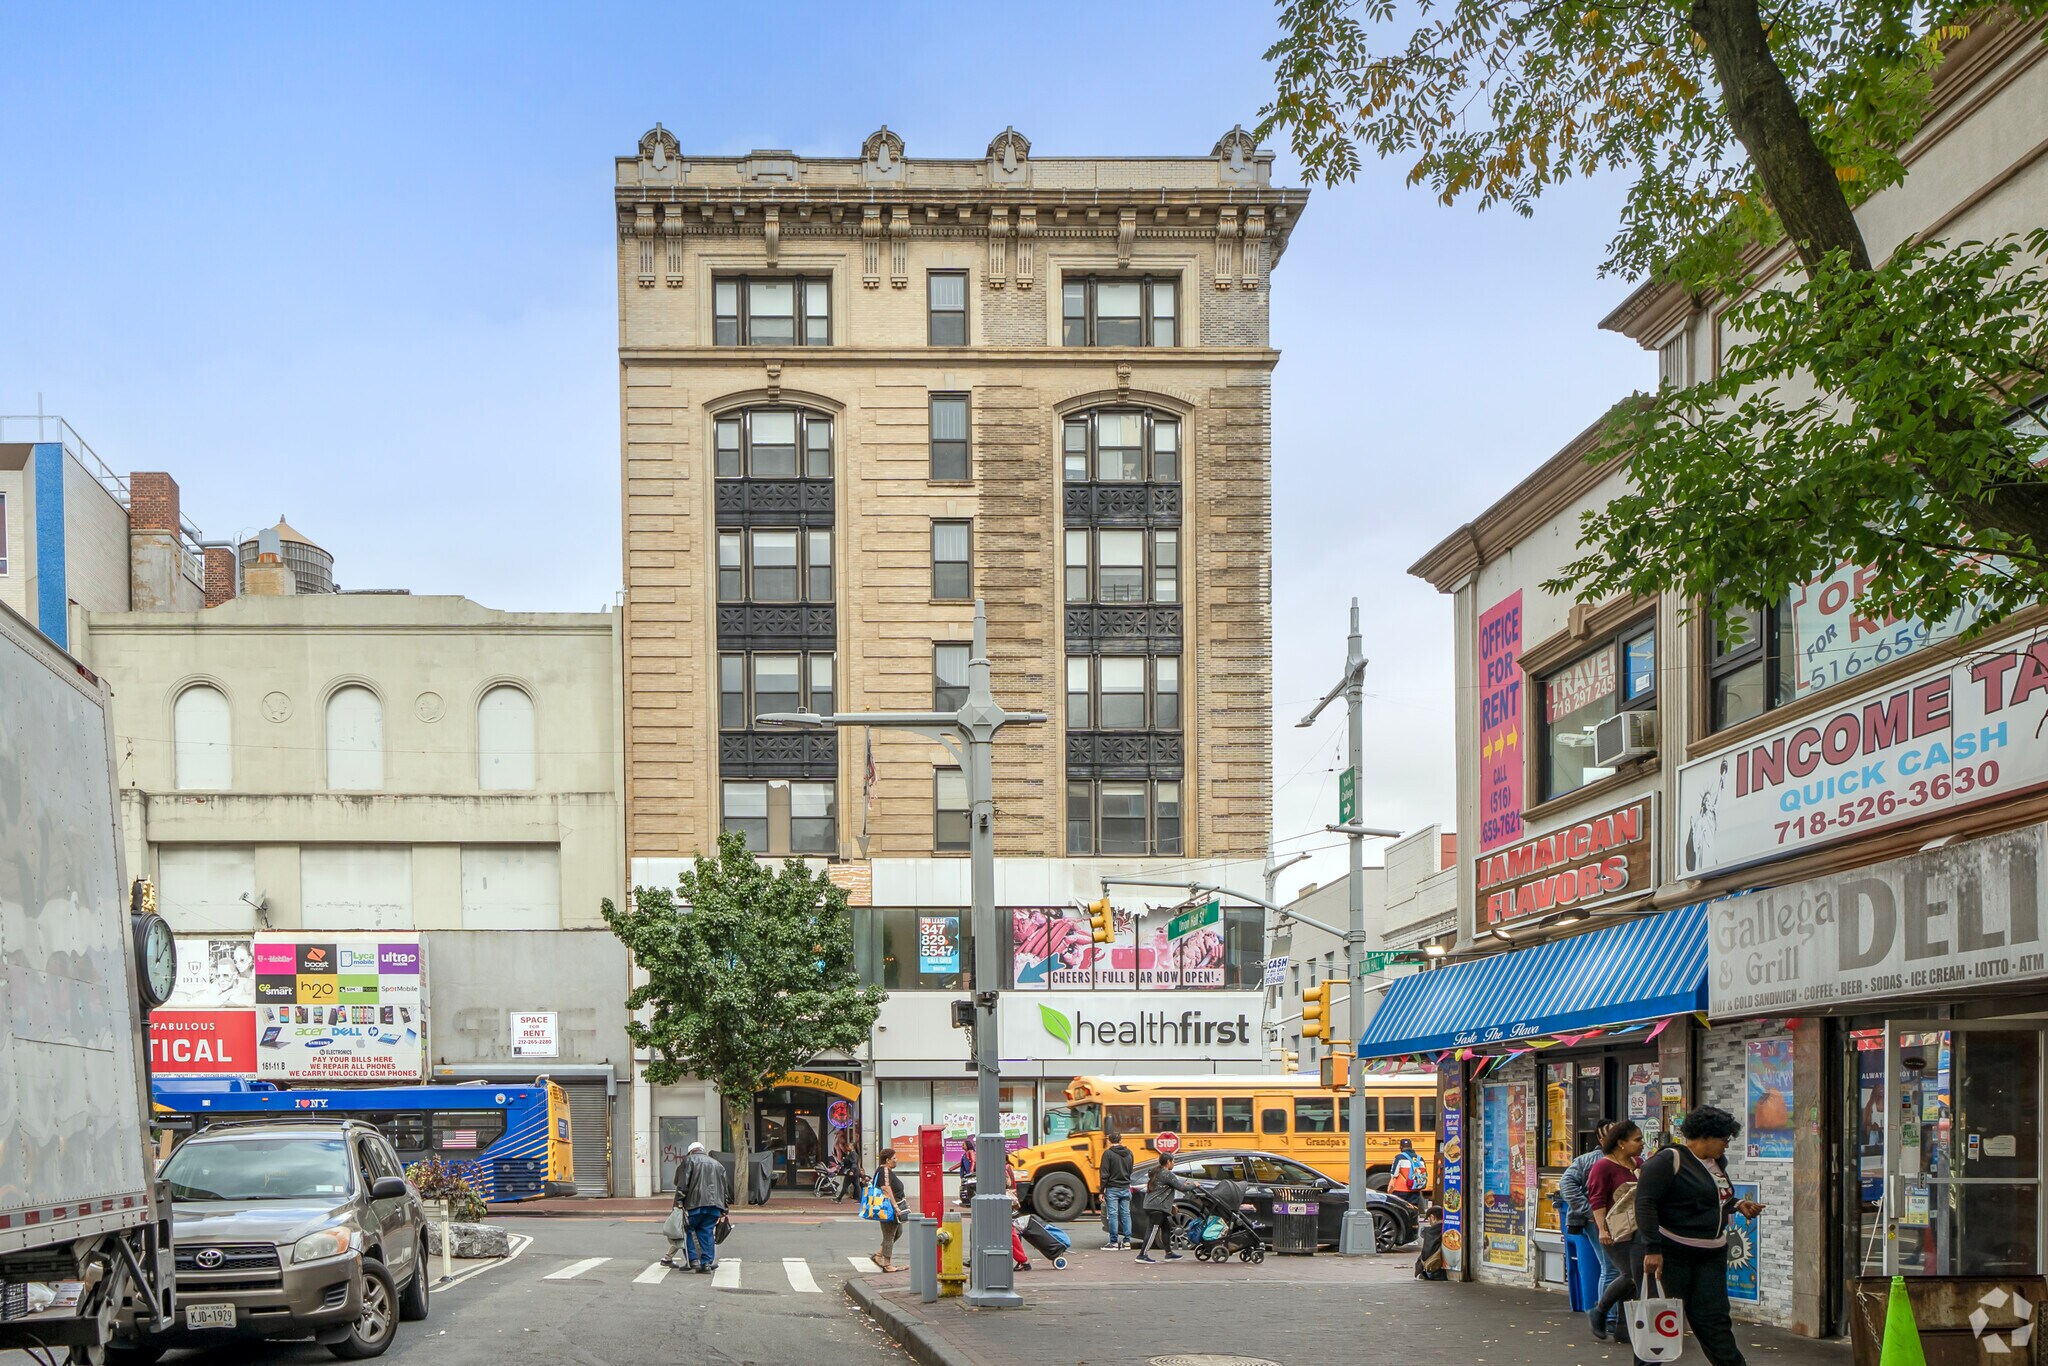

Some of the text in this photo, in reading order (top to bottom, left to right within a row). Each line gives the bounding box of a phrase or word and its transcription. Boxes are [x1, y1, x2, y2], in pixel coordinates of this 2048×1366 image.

[1482, 607, 1518, 660] OFFICE
[1806, 624, 1838, 663] FOR
[1488, 651, 1513, 689] FOR
[1482, 680, 1519, 733] RENT
[1552, 698, 1571, 719] 718
[1574, 686, 1592, 710] 297
[1735, 674, 1951, 798] INCOME
[1493, 764, 1507, 786] CALL
[1779, 721, 2008, 813] QUICK CASH
[1490, 785, 1511, 814] (516)
[1774, 760, 2000, 845] 718-526-3630
[1483, 809, 1520, 843] 659-7621
[1477, 804, 1644, 891] JAMAICAN
[1487, 855, 1630, 926] FLAVORS
[1838, 840, 2040, 971] DELI
[921, 924, 945, 935] 347
[1714, 890, 1836, 955] Gallega
[921, 935, 946, 946] 829
[921, 946, 954, 957] 5547
[353, 952, 375, 960] Lyca
[1268, 957, 1288, 969] CASH
[1719, 945, 1800, 990] & Grill
[1102, 971, 1126, 983] FULL
[1156, 971, 1179, 983] NOW
[1185, 971, 1214, 983] OPEN!
[1728, 1002, 1733, 1011] &
[1734, 995, 1753, 1010] COLD
[1755, 988, 1797, 1007] SANDWICH
[1804, 983, 1833, 1000] COFFEE
[1841, 980, 1862, 995] BEER
[1871, 974, 1902, 992] SODAS
[1911, 970, 1926, 987] ICE
[1929, 965, 1965, 984] CREAM
[1975, 958, 2008, 978] LOTTO
[2019, 953, 2044, 972] ATM
[153, 1022, 215, 1031] FABULOUS
[295, 1027, 327, 1036] acer
[332, 1027, 362, 1036] DELL
[1076, 1010, 1250, 1045] healthfirst
[1453, 1031, 1478, 1046] Taste
[1483, 1027, 1503, 1042] The
[262, 1062, 286, 1070] 161-11 B
[803, 1075, 838, 1090] Back!
[295, 1099, 329, 1108] I NY
[1158, 1138, 1177, 1149] STOP
[1306, 1137, 1346, 1147] Grandpa's
[1903, 1131, 1919, 1139] PULL
